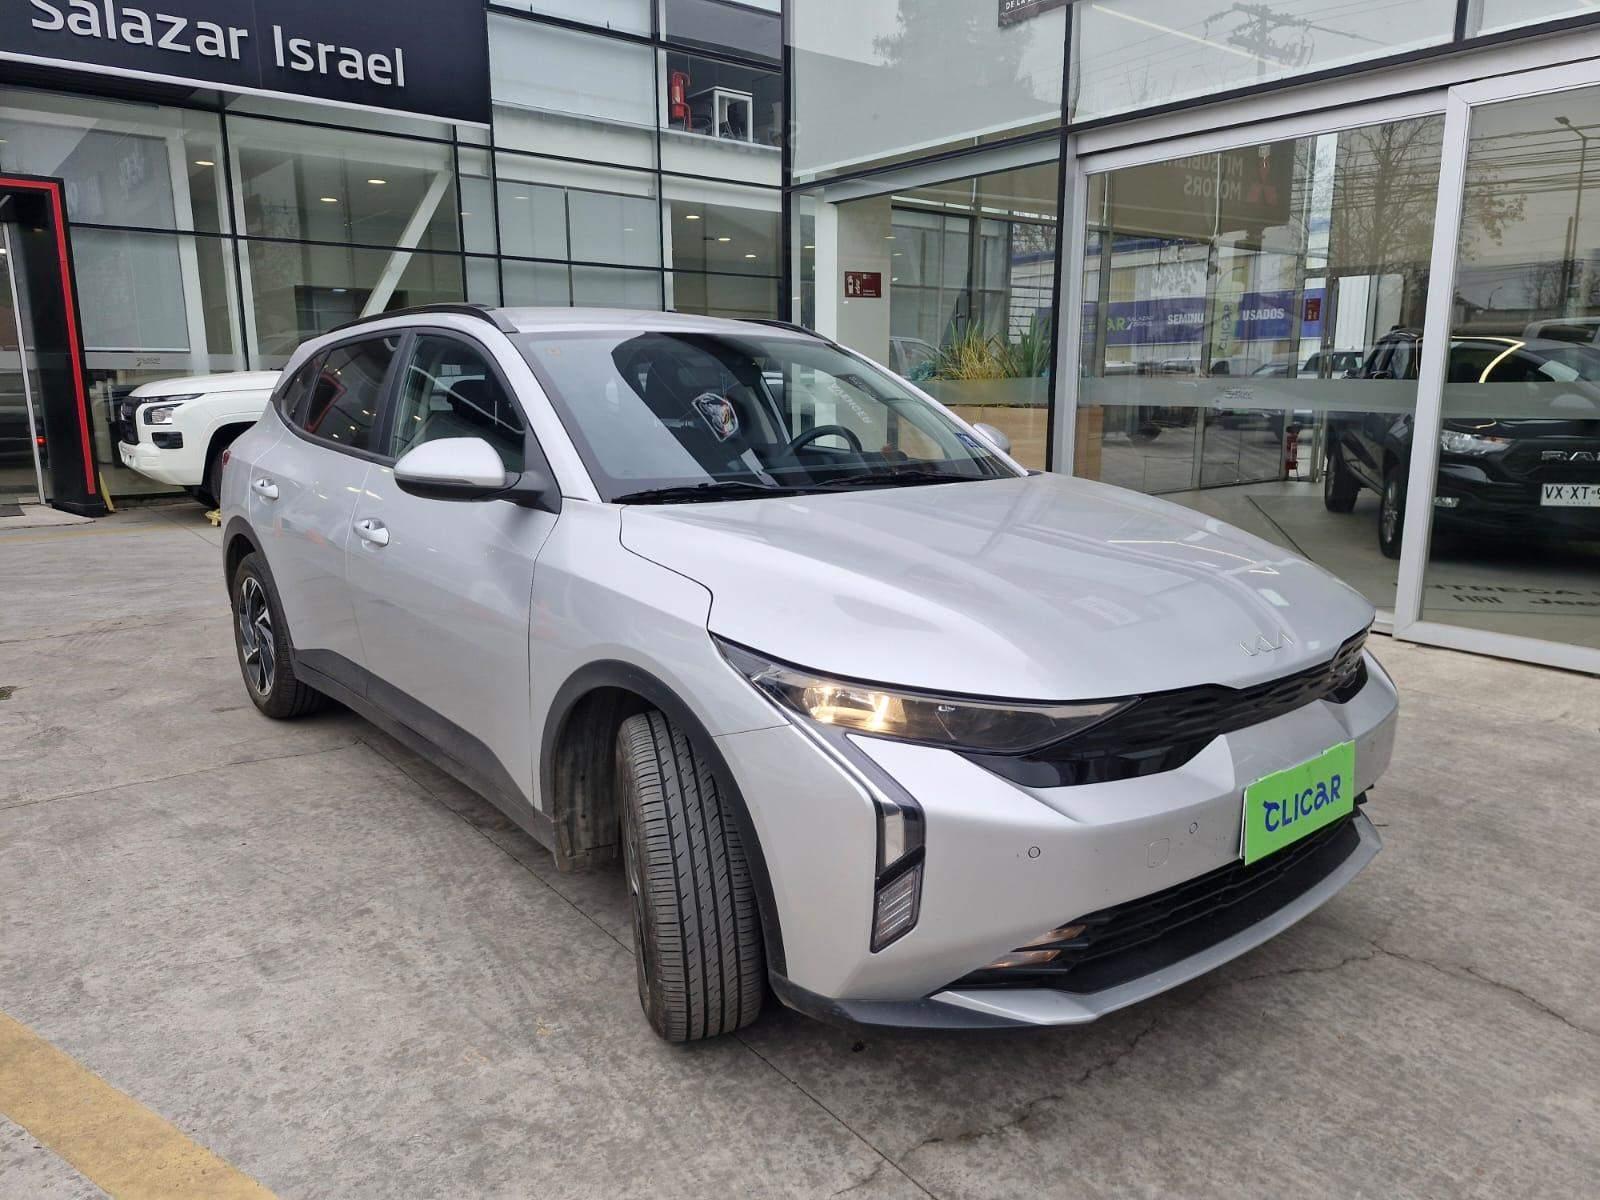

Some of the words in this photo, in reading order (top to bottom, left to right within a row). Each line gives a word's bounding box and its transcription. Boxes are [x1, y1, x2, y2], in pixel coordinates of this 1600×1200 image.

[30, 0, 248, 60] Salazar
[272, 24, 405, 87] Israel
[1242, 308, 1285, 321] USADOS
[1540, 450, 1600, 461] RA
